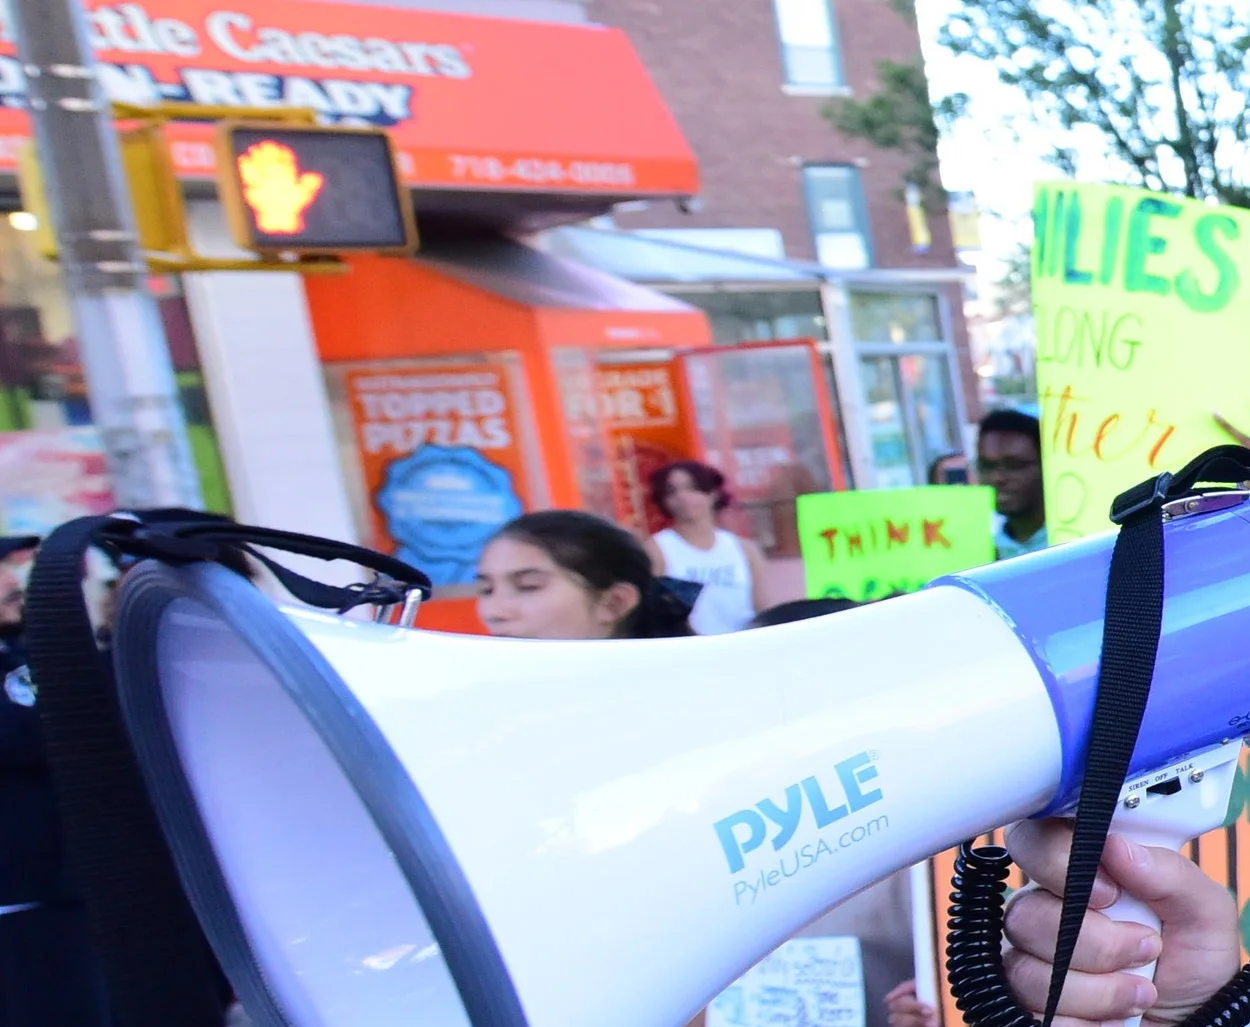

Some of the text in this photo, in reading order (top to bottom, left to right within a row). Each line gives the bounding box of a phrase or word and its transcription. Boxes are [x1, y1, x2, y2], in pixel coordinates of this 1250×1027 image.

[206, 11, 471, 79] Caesars
[818, 518, 952, 562] THINK
[1129, 764, 1193, 792] SIREN OFF TALK
[713, 751, 884, 874] PYLE
[733, 815, 889, 906] PyleUSA.com
